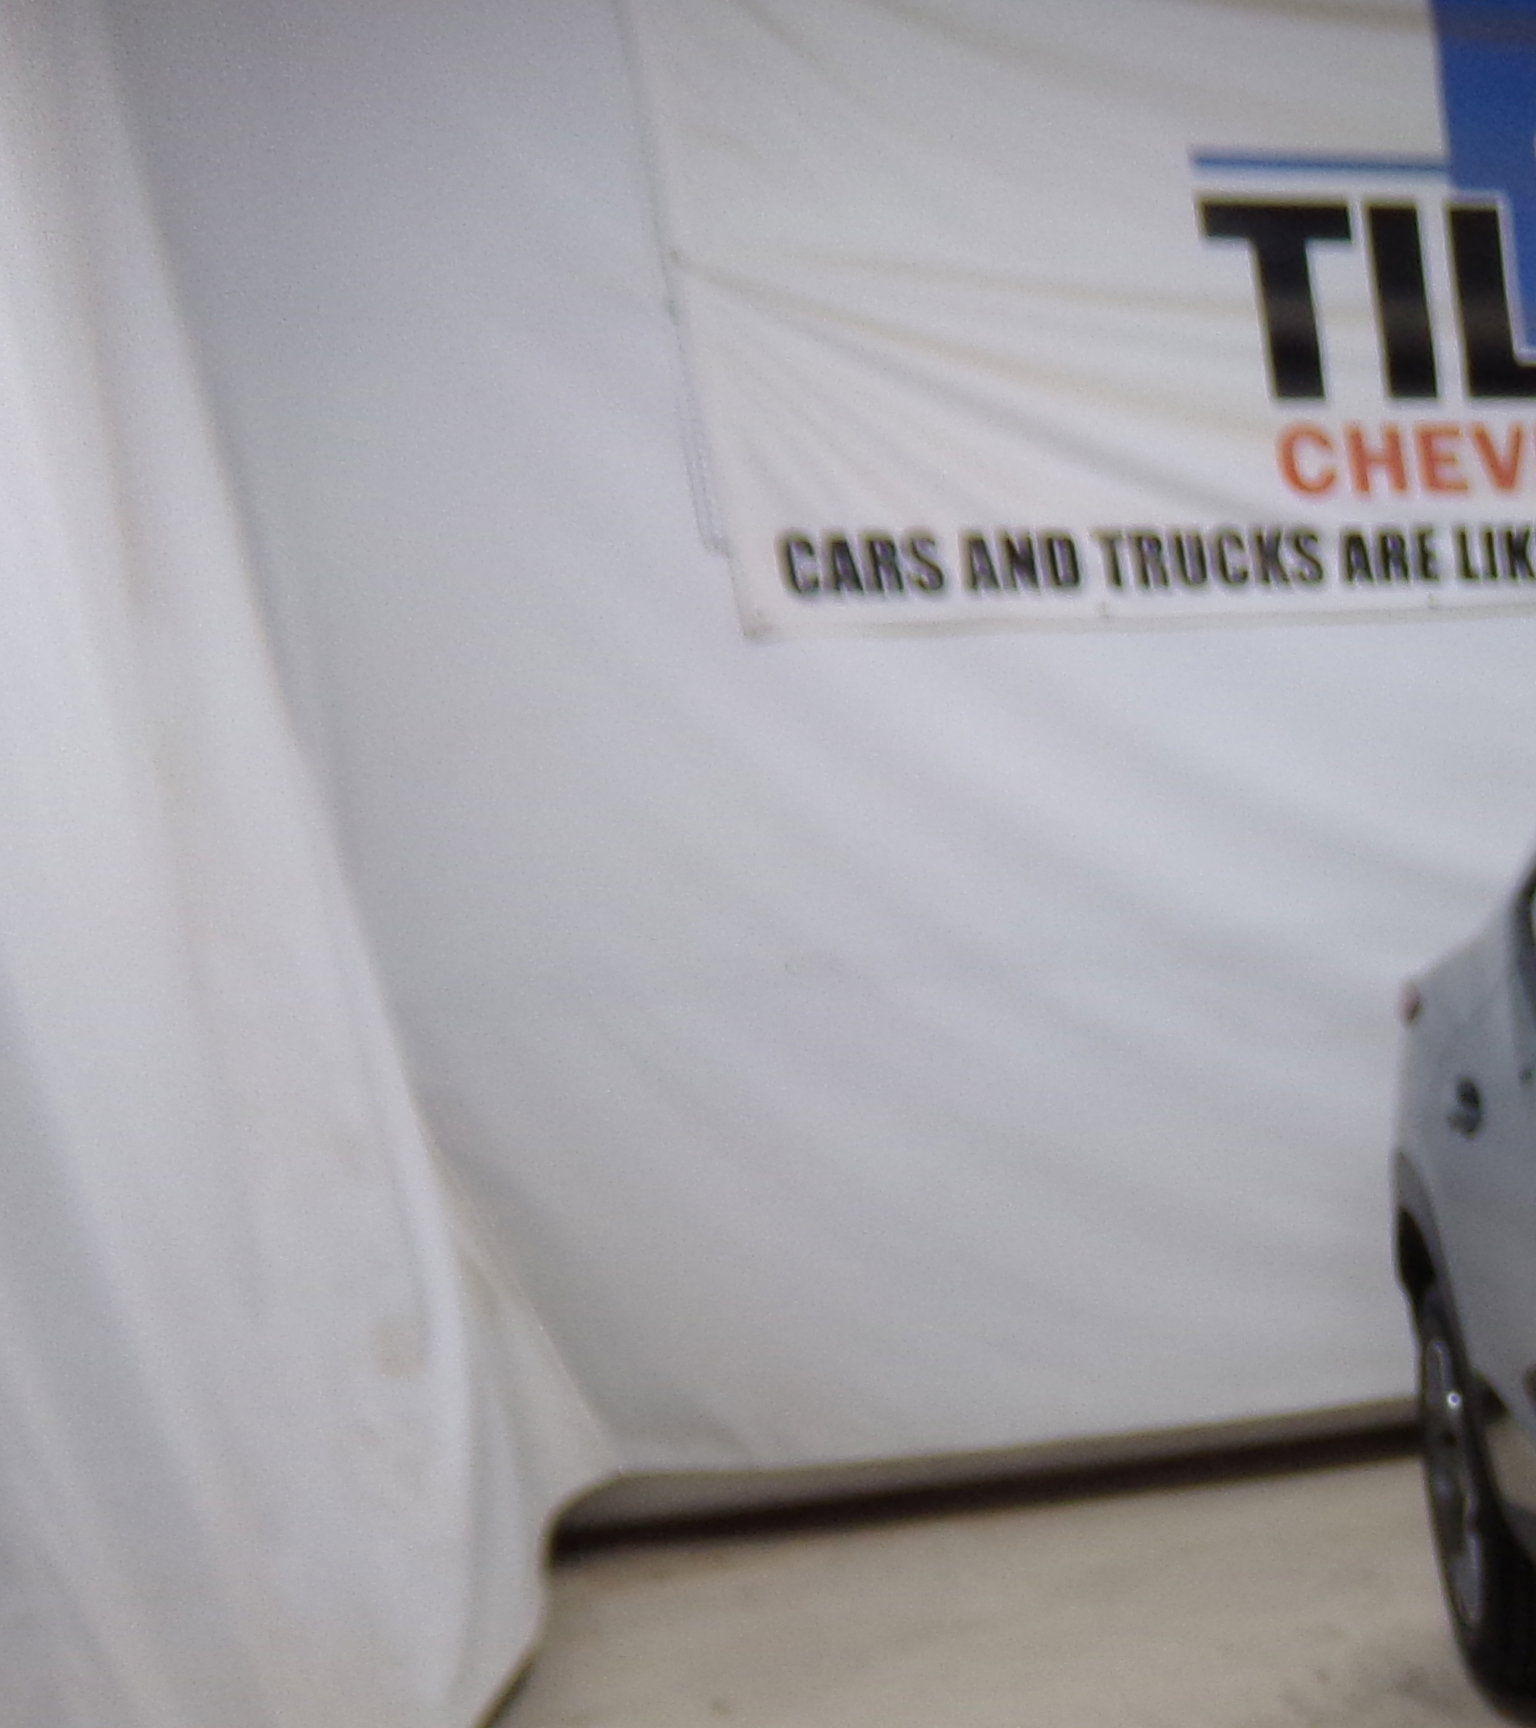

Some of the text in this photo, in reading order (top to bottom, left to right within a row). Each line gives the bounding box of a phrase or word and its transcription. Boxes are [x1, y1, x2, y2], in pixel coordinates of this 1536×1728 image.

[779, 531, 947, 597] CARS
[964, 531, 1083, 593] AND
[1096, 527, 1325, 590] TRUCKS
[1338, 526, 1441, 584] ARE
